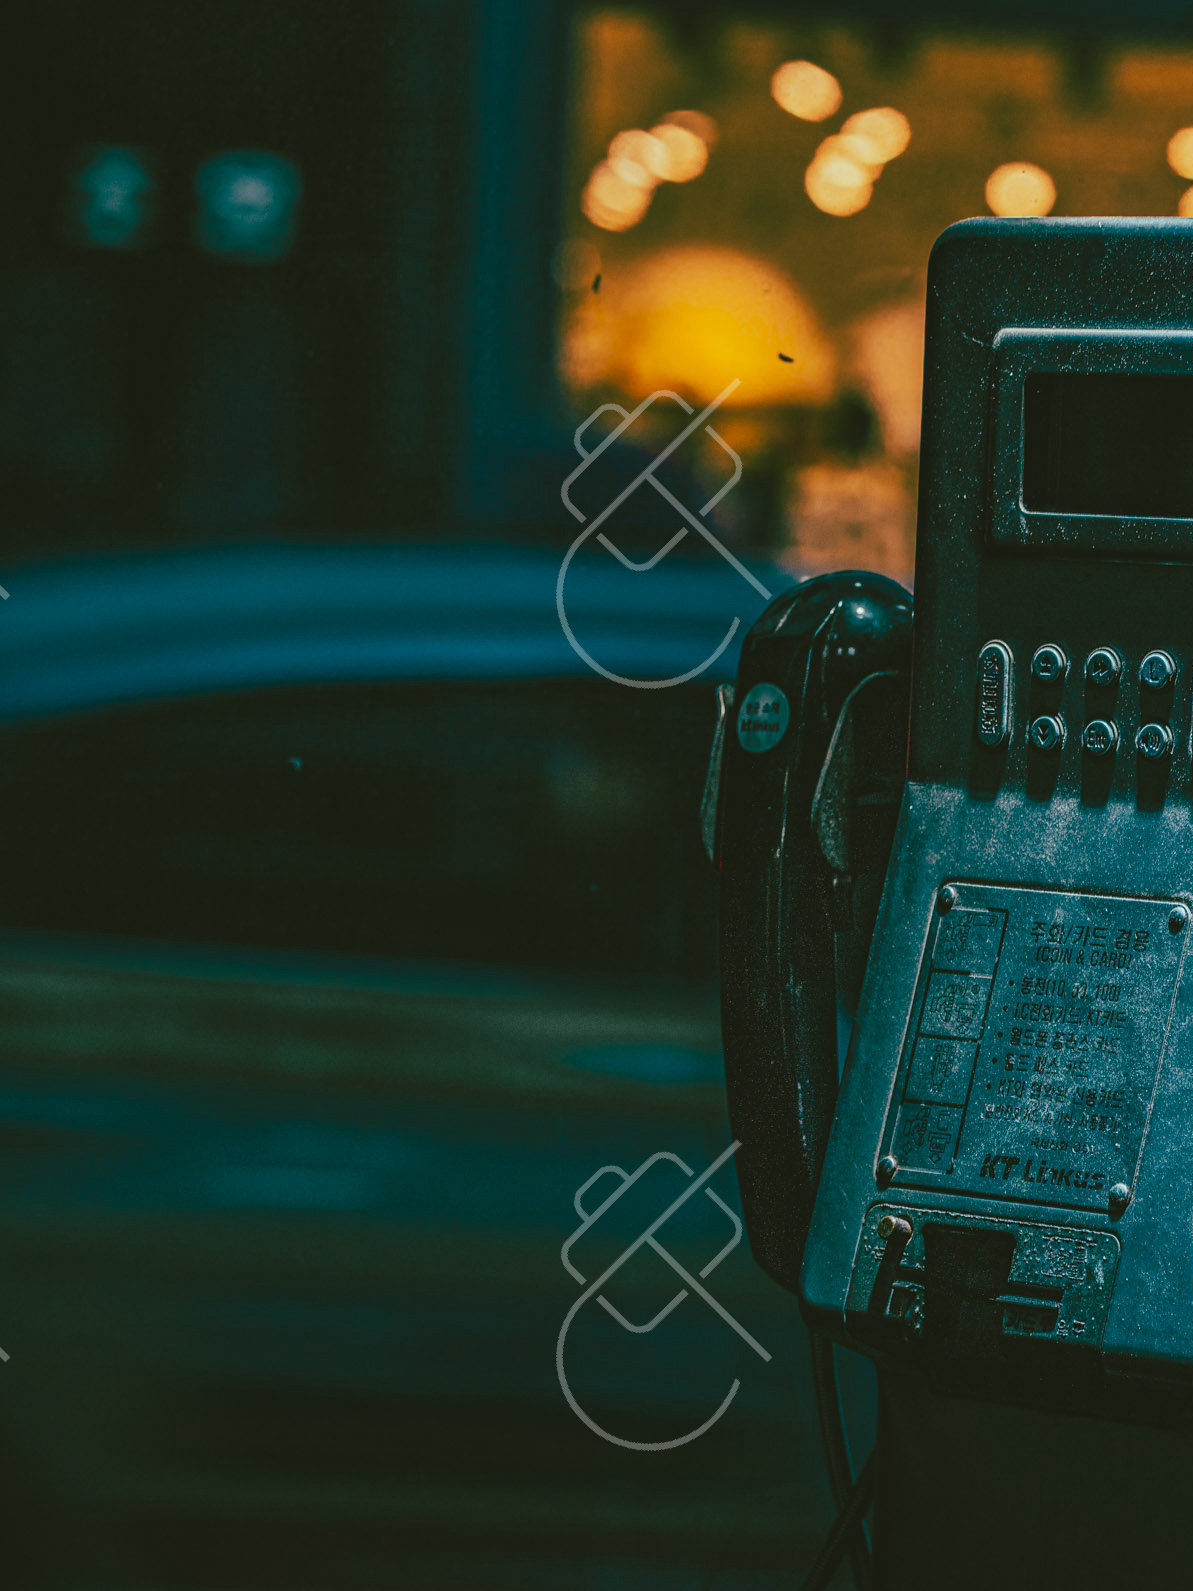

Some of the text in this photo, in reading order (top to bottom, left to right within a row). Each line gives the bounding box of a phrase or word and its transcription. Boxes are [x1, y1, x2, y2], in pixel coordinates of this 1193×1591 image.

[1030, 921, 1150, 953] 주화/카드 겸용
[1035, 945, 1133, 970] (COIN & CARD)
[1071, 1086, 1125, 1109] 신용카드
[979, 1153, 1107, 1191] KT Linkus
